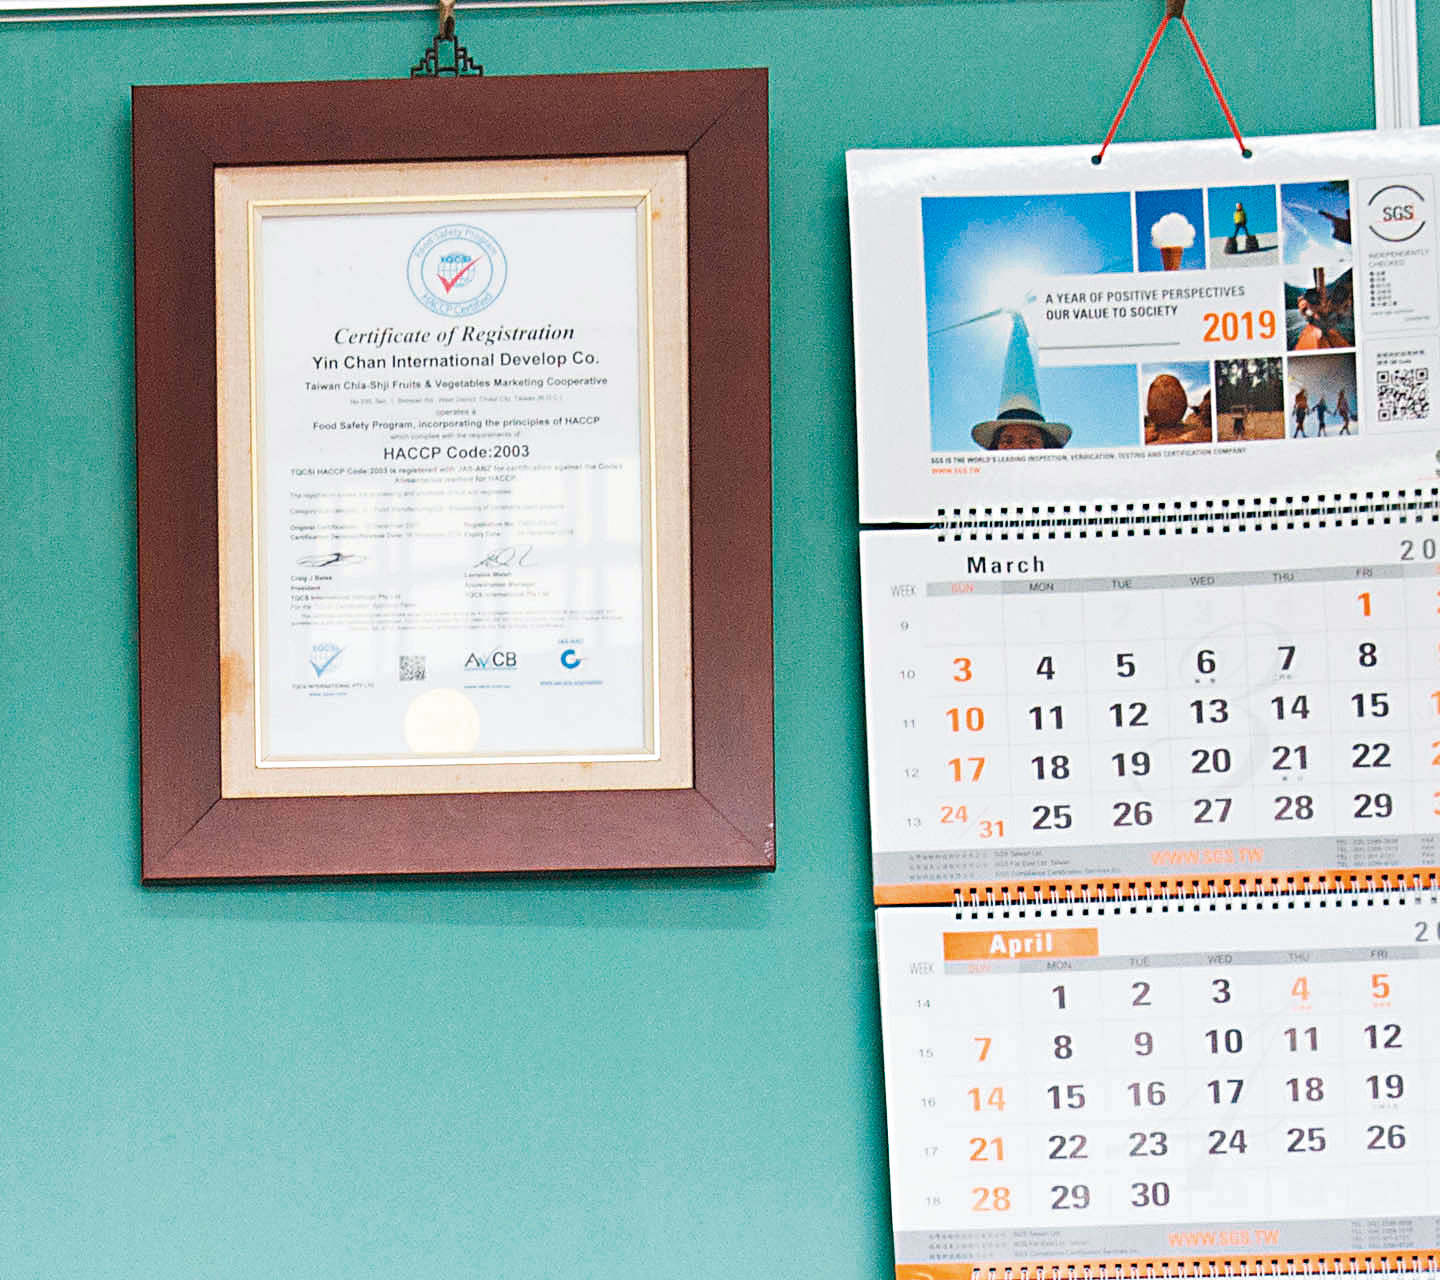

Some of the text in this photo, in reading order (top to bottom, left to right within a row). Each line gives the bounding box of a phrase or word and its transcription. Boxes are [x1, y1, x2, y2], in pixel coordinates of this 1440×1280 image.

[1383, 205, 1414, 222] SGS
[1046, 286, 1245, 303] A YEAR OF POSITIVE PERSPECTIVES
[1047, 305, 1177, 320] OUR VALUE TO SOCIETY
[1204, 310, 1275, 342] 2019
[334, 325, 575, 348] Certificate of Registration
[312, 350, 601, 370] Yin Chan International Develop Co.
[305, 376, 608, 392] Taiwan Chia-Shji Fruits & Vegetables Marketing Cooperative
[312, 415, 600, 432] Food Safety Program, incorporating the principles of HACCP
[383, 444, 530, 461] HACCP Code:2003
[968, 556, 1043, 573] March
[1029, 582, 1054, 593] MON
[1111, 579, 1133, 590] TUE
[1190, 575, 1215, 587] WED
[1272, 572, 1295, 582] THU
[1355, 567, 1374, 578] FRI
[1358, 592, 1371, 616] 1
[953, 657, 972, 682] 3
[1036, 656, 1055, 680] 4
[1117, 653, 1135, 677] 5
[1197, 650, 1216, 674] 6
[1278, 646, 1295, 670] 7
[1359, 643, 1377, 667] 8
[989, 931, 1054, 958] April
[1053, 985, 1065, 1009] 1
[1132, 982, 1151, 1006] 2
[1212, 979, 1231, 1003] 3
[1292, 976, 1309, 1000] 4
[1372, 974, 1390, 998] 5
[1168, 1228, 1280, 1249] WWW.SGS.TW
